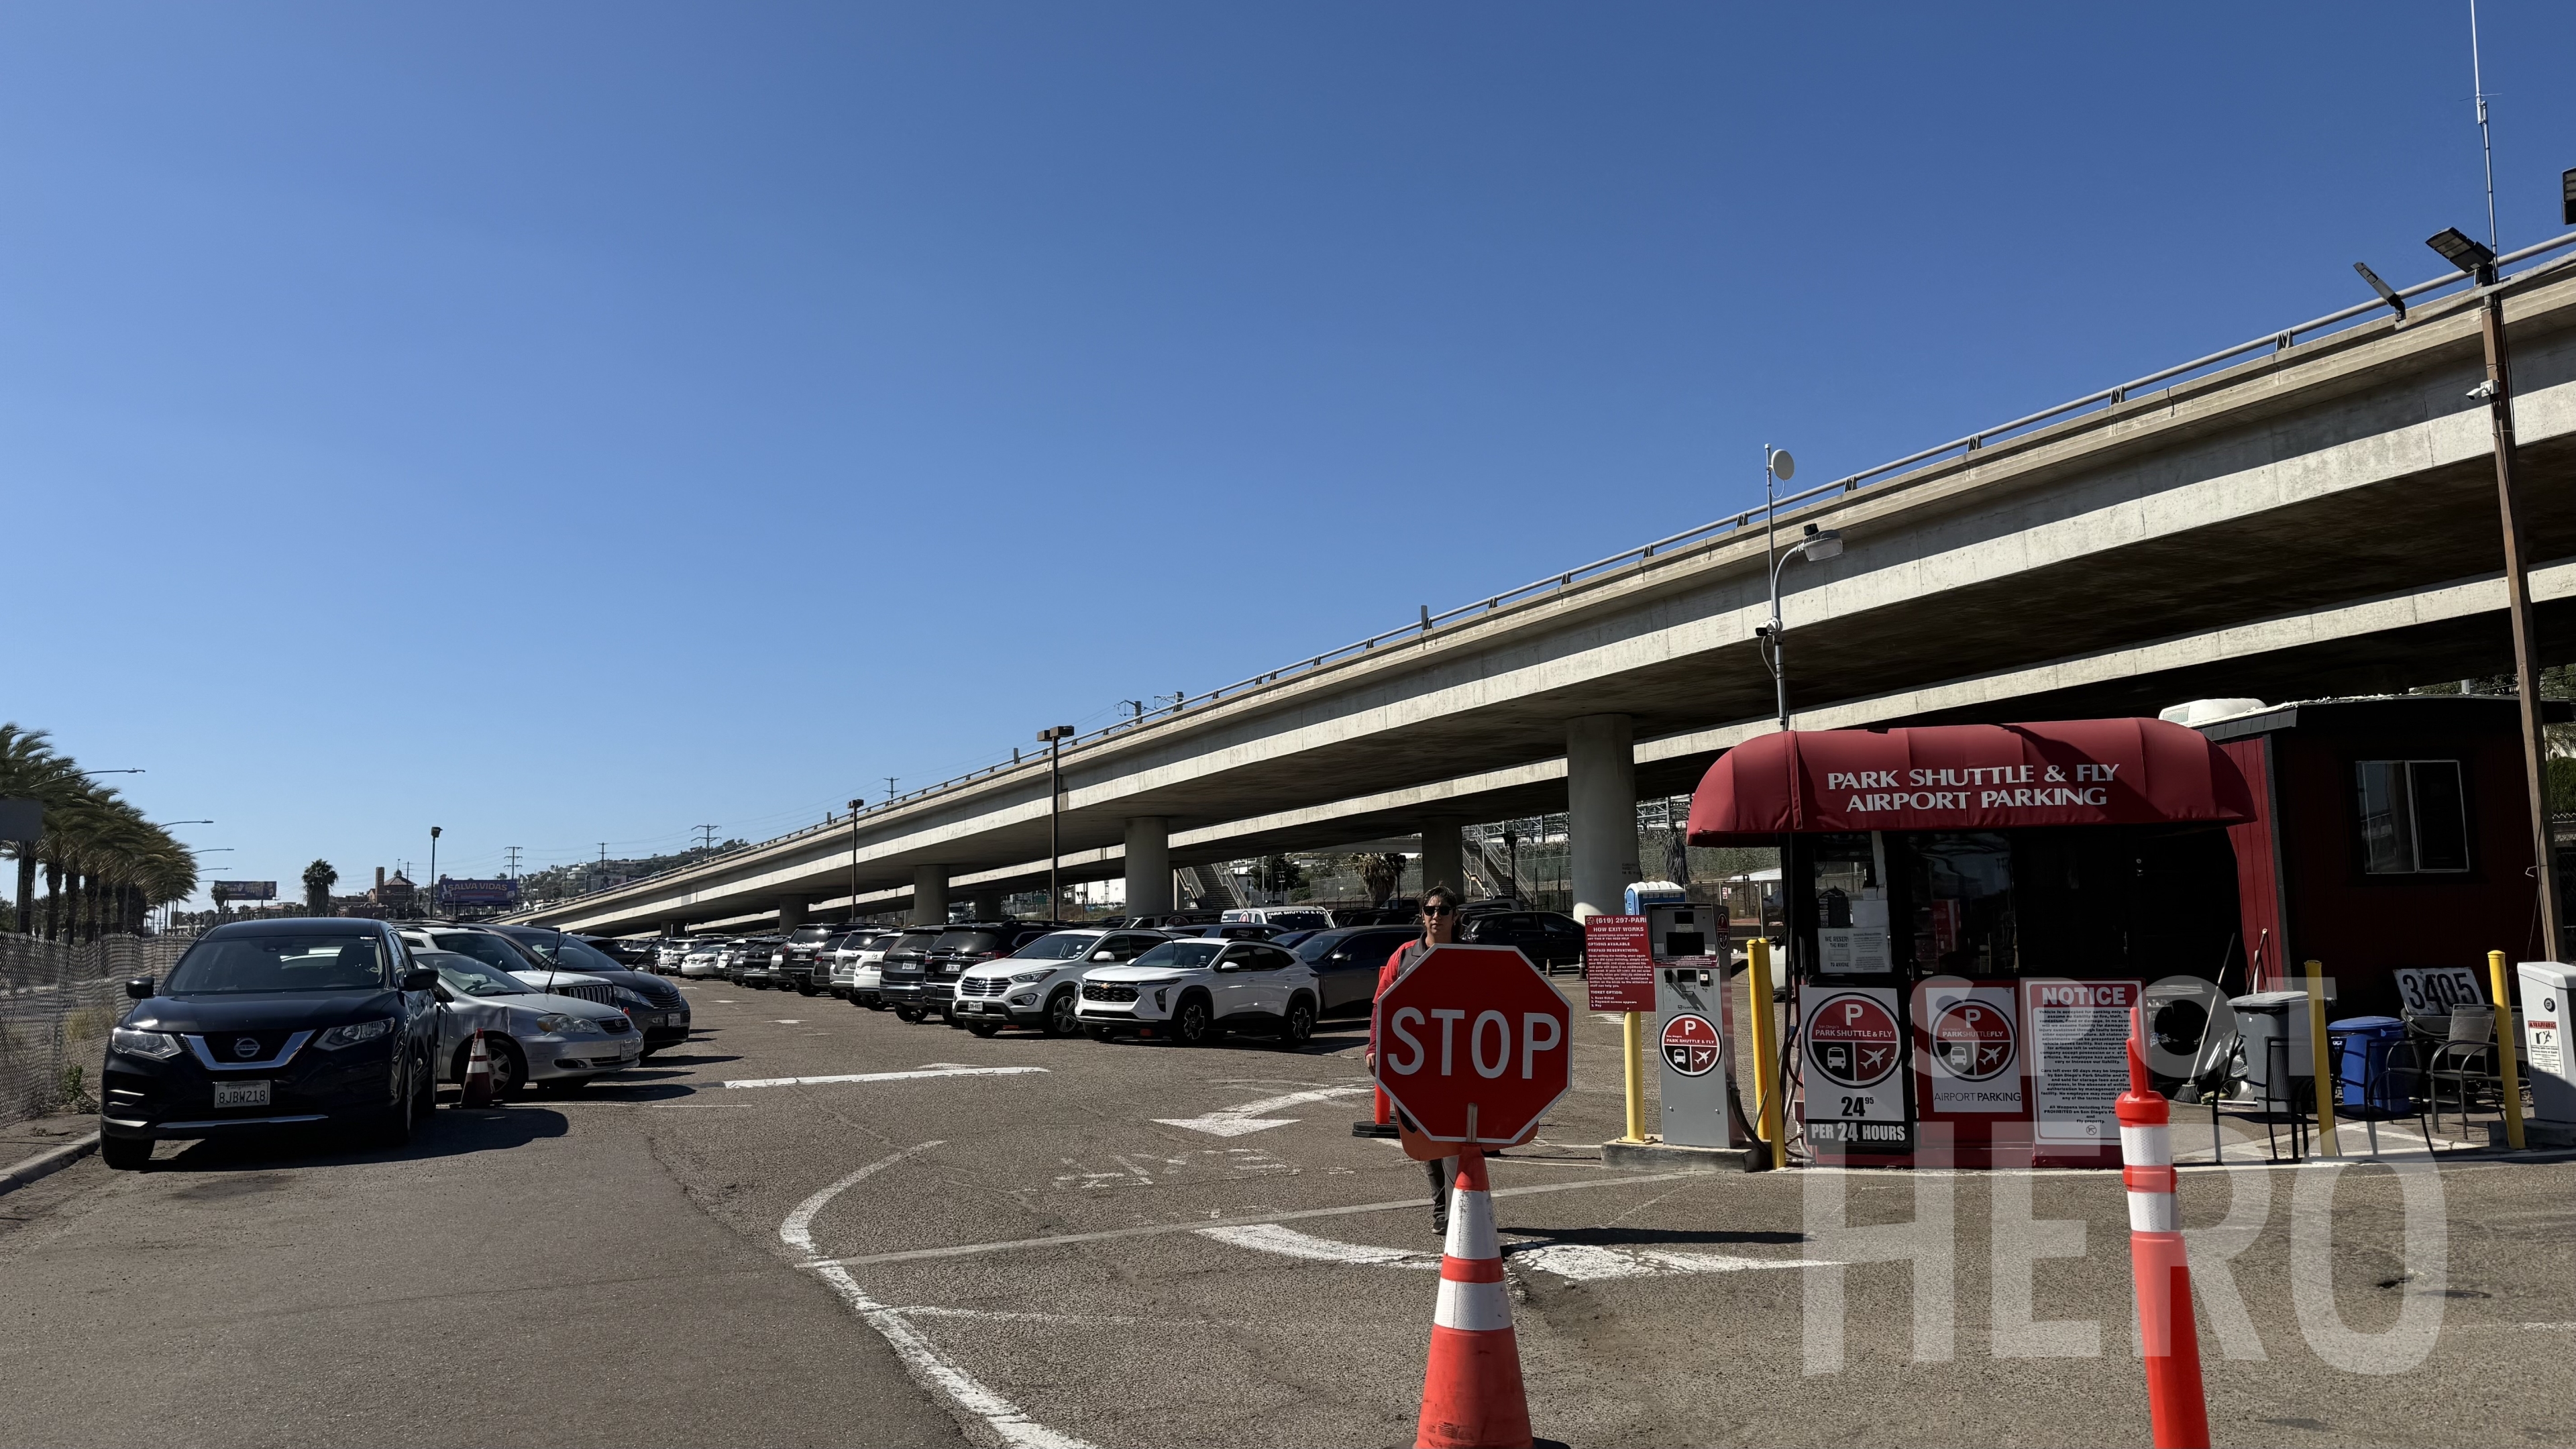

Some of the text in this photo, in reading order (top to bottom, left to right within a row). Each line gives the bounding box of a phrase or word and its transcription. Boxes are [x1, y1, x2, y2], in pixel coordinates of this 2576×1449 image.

[1827, 763, 2120, 790] PARK SHUTTLE & FLY
[1845, 788, 2106, 812] AIRPORT PARKING
[448, 883, 507, 891] SALVA VIDAS
[2042, 987, 2126, 1005] NOTICE
[2402, 973, 2478, 1015] 3405
[1845, 1004, 1864, 1026] P
[1965, 1009, 1981, 1028] P
[1684, 1020, 1697, 1035] P
[1387, 1007, 1561, 1079] STOP
[219, 1090, 266, 1104] 8JBW218
[1812, 1122, 1905, 1142] PER 24 HOURS
